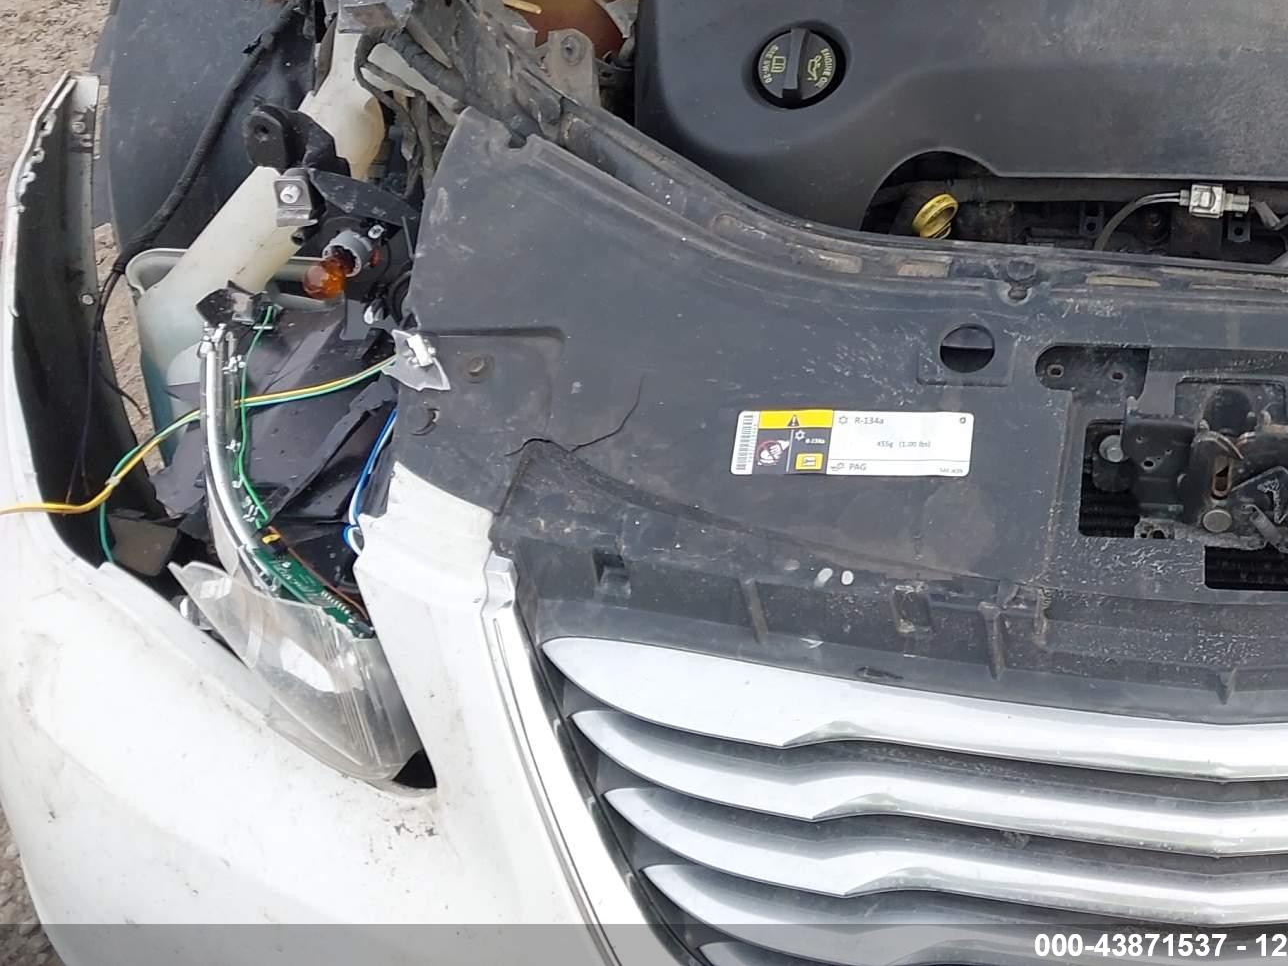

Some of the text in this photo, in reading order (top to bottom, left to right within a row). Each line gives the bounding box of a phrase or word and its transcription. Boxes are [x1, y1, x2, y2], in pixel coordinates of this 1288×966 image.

[820, 48, 834, 76] ENGINE
[854, 416, 885, 425] R-134a
[848, 463, 867, 471] PAG
